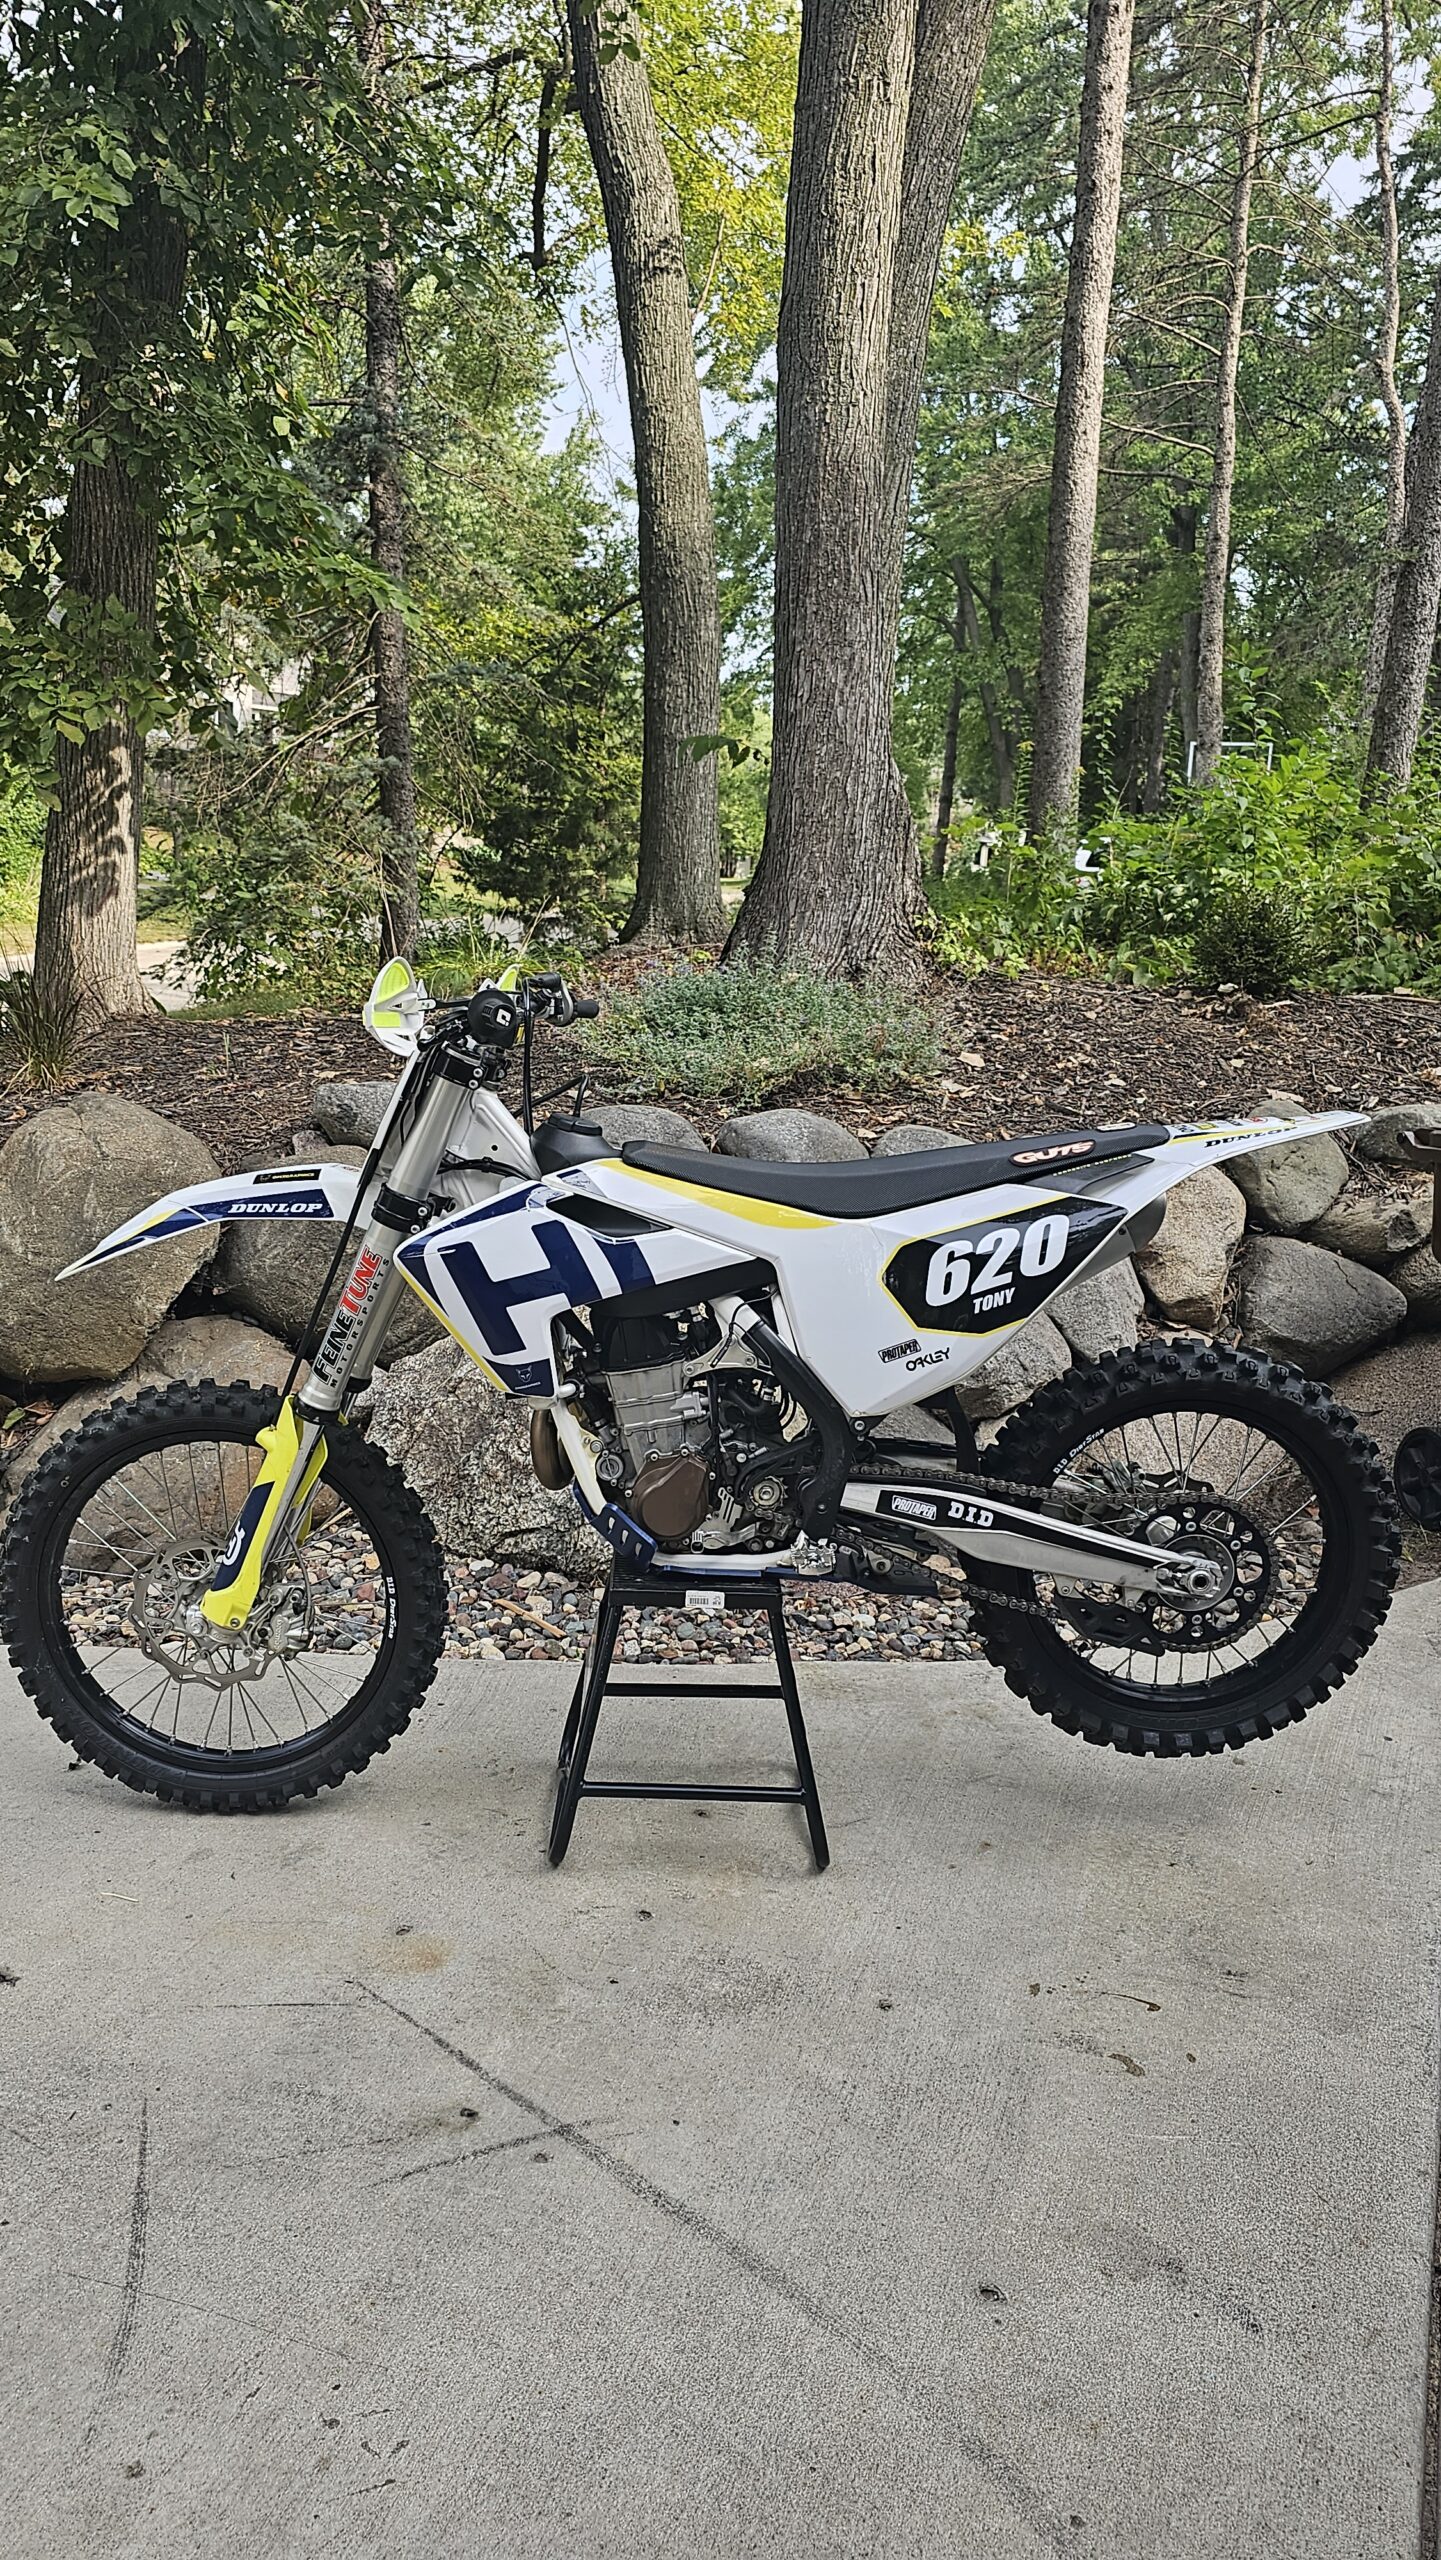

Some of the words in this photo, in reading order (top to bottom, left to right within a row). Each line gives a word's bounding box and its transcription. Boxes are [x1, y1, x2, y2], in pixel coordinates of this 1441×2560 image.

[1012, 1141, 1095, 1163] GUTS
[227, 1203, 323, 1214] DUNLOP
[925, 1214, 1070, 1307] 620
[973, 1287, 1016, 1315] TONY
[330, 1259, 390, 1389] MOTORSPORTS
[879, 1340, 921, 1363] PROTAPER
[905, 1347, 950, 1372] OAKLEY
[892, 1496, 937, 1520] PROTAPER
